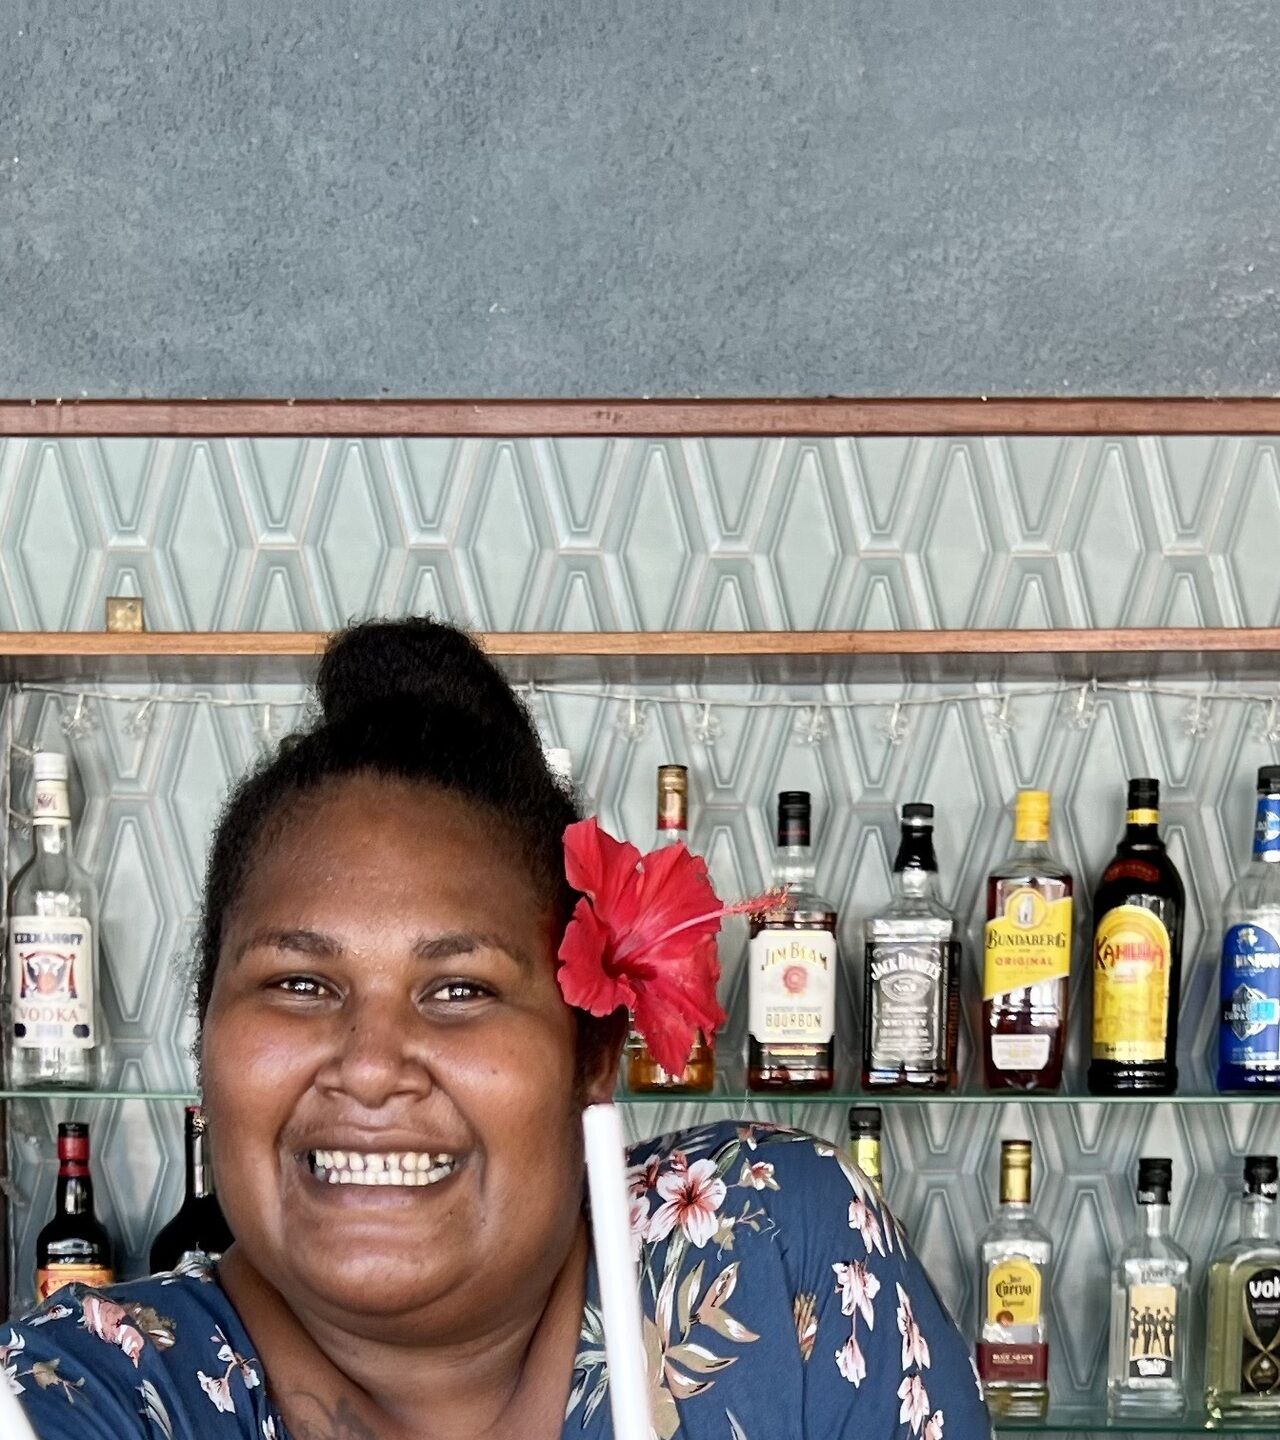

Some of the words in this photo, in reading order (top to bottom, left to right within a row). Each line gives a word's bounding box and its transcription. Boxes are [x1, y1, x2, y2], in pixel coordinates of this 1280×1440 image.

[986, 928, 1067, 949] BUNDABERG
[760, 947, 787, 972] JIM
[790, 941, 828, 971] BEAM
[994, 956, 1054, 967] ORIGINAL
[18, 1006, 78, 1023] VODKA
[765, 1012, 823, 1029] BOURBON
[995, 1280, 1032, 1298] Cuervo
